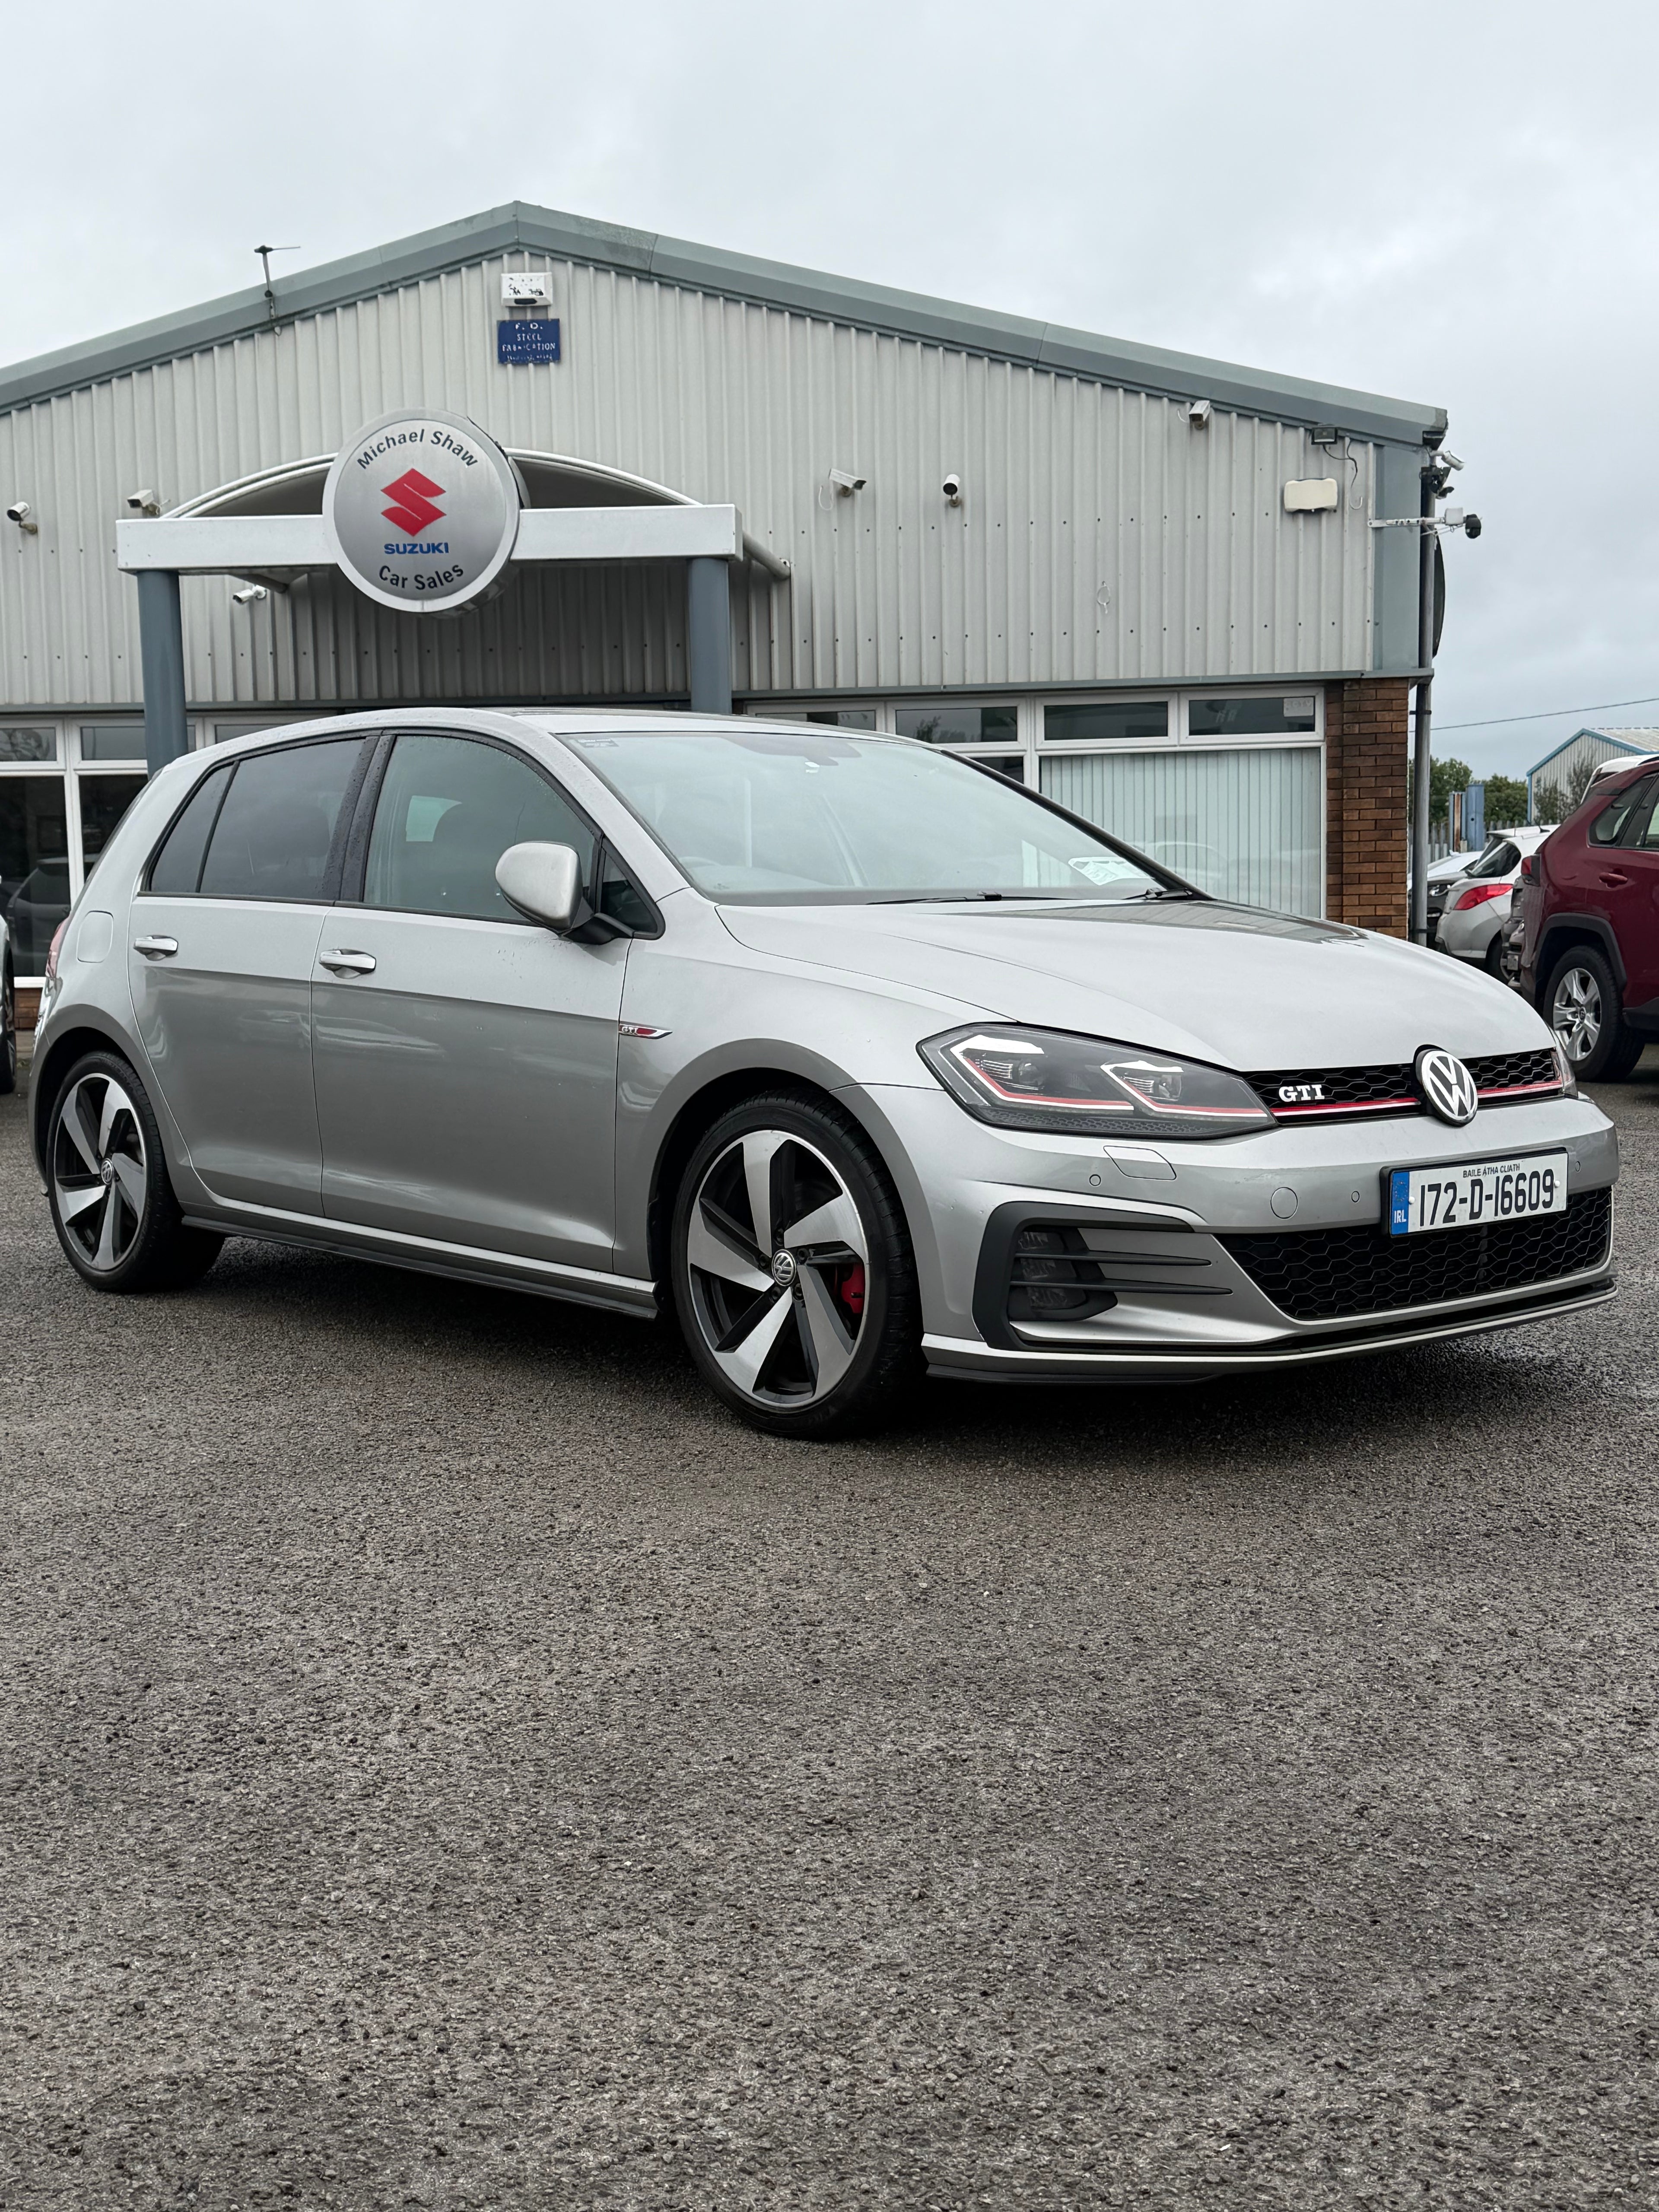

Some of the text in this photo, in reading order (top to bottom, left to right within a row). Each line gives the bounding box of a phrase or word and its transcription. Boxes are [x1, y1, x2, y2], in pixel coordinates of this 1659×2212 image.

[357, 429, 478, 470] Michael Shaw
[384, 542, 449, 554] SUZUKI
[379, 564, 464, 590] Car Sales
[621, 1026, 638, 1034] GTI
[1278, 1084, 1325, 1102] GTI
[1463, 1169, 1481, 1178] BAILE
[1500, 1163, 1520, 1173] CLIATH
[1420, 1169, 1554, 1227] 172-D-16609
[1394, 1210, 1407, 1224] IRL
